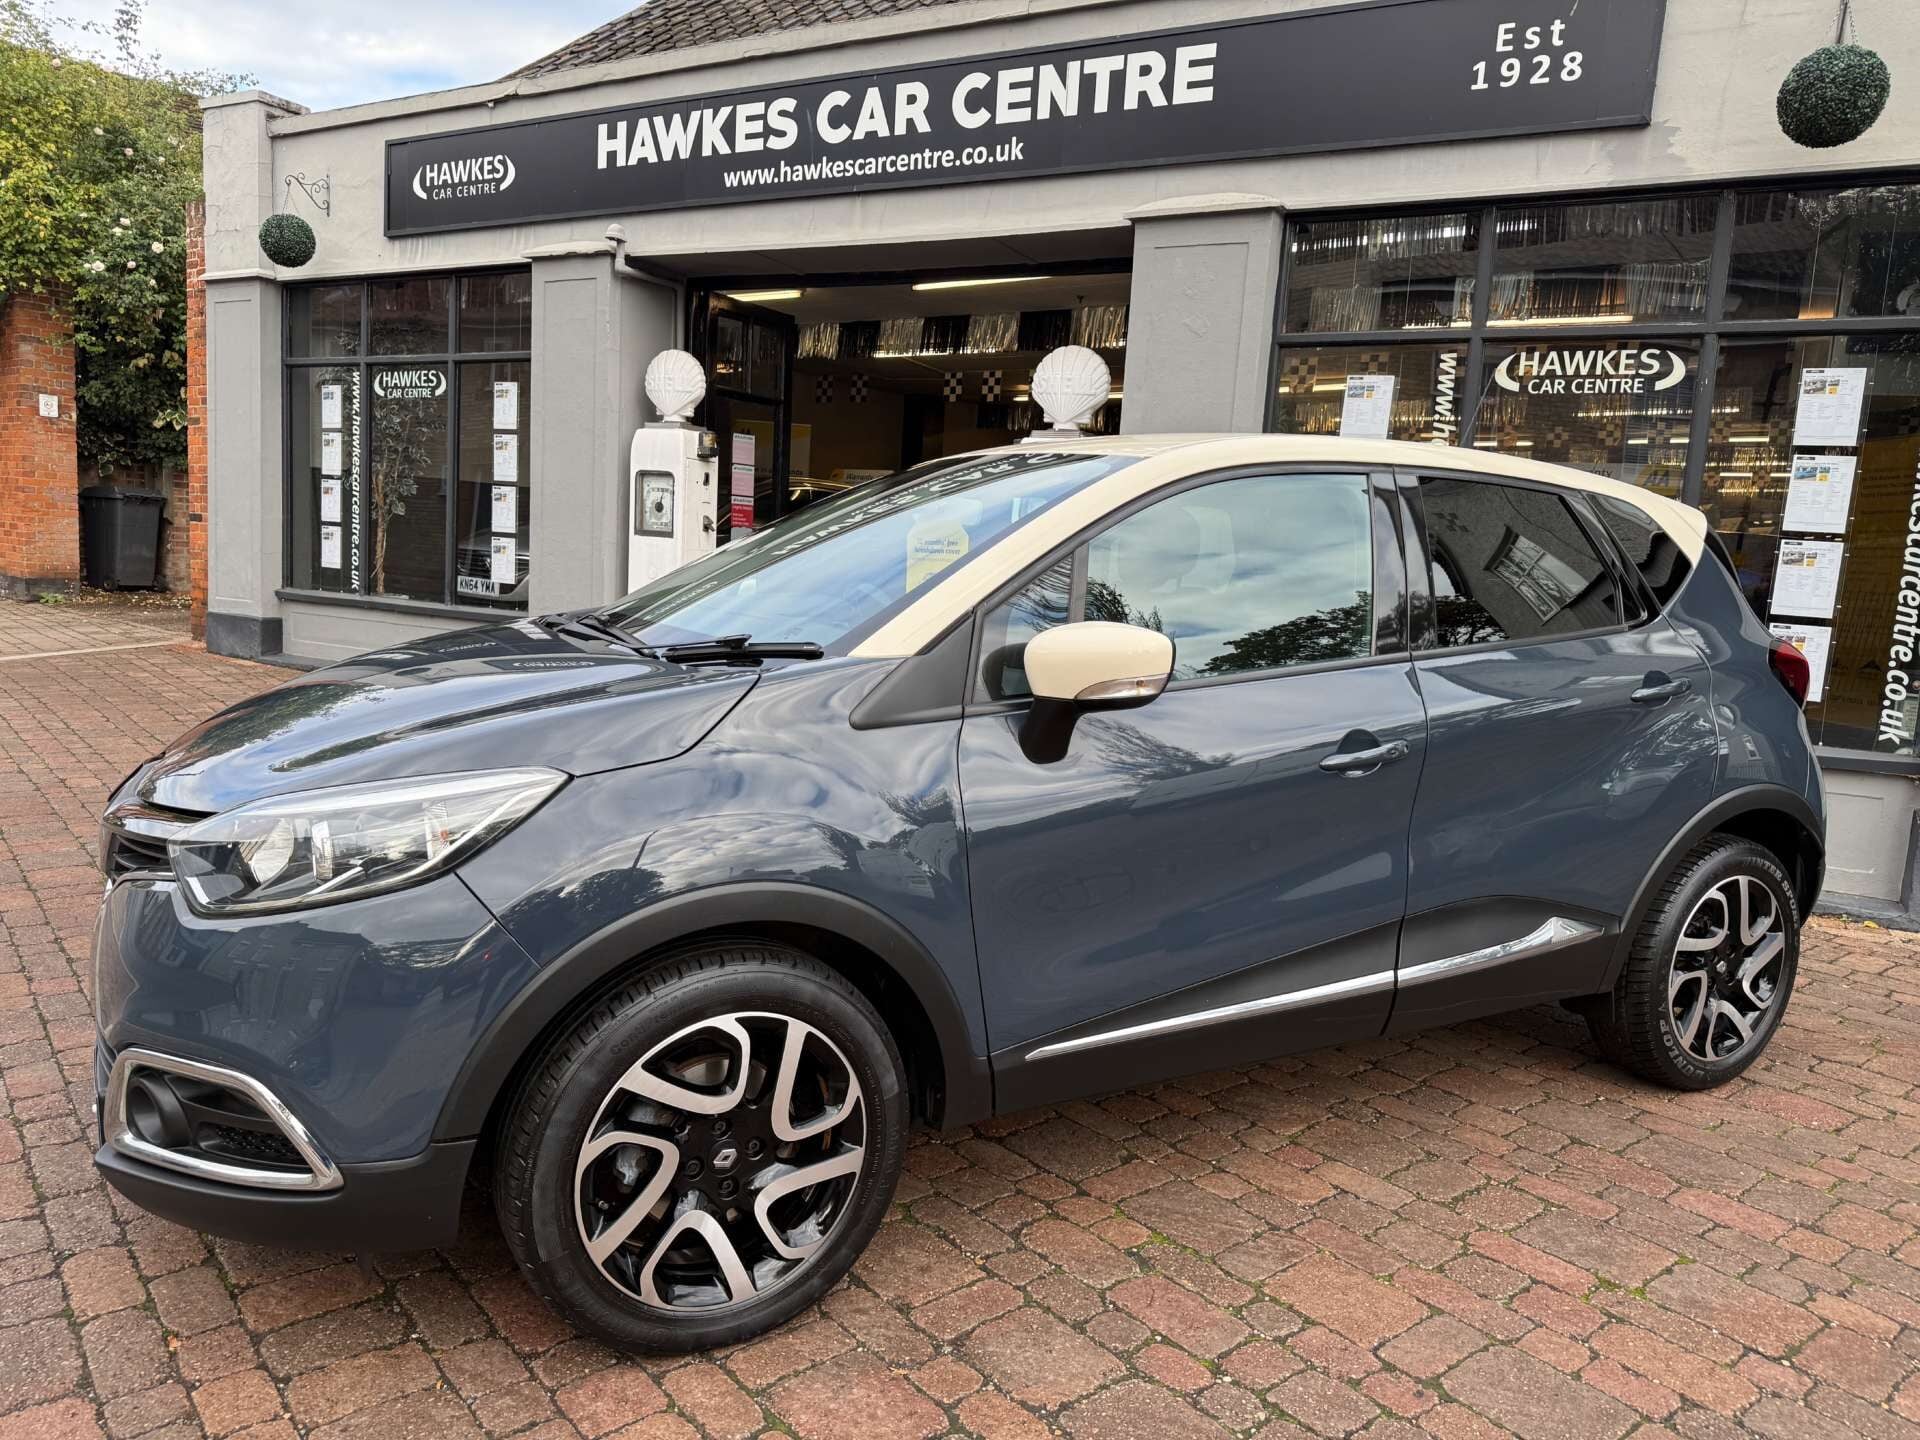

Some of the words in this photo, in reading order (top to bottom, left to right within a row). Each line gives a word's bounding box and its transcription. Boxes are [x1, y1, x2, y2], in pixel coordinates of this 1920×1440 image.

[1496, 19, 1565, 52] Est
[1471, 51, 1583, 90] 1928
[597, 97, 798, 169] HAWKES
[816, 81, 932, 144] CAR
[952, 43, 1217, 129] CENTRE
[426, 154, 504, 187] HAWKES
[724, 136, 1024, 188] www.hawkescarcentre.co.uk
[433, 187, 452, 200] CAR
[457, 182, 496, 197] CENTRE
[382, 370, 437, 388] HAWKES
[1518, 349, 1661, 376] HAWKES
[387, 388, 402, 398] CAR
[404, 388, 432, 398] CENTRE
[1527, 379, 1565, 394] CAR
[1571, 378, 1645, 394] CENTRE
[351, 371, 361, 590] www.hawkescarcentre.co.uk
[459, 578, 478, 591] KN64
[1660, 1019, 1705, 1078] DUNLOP
